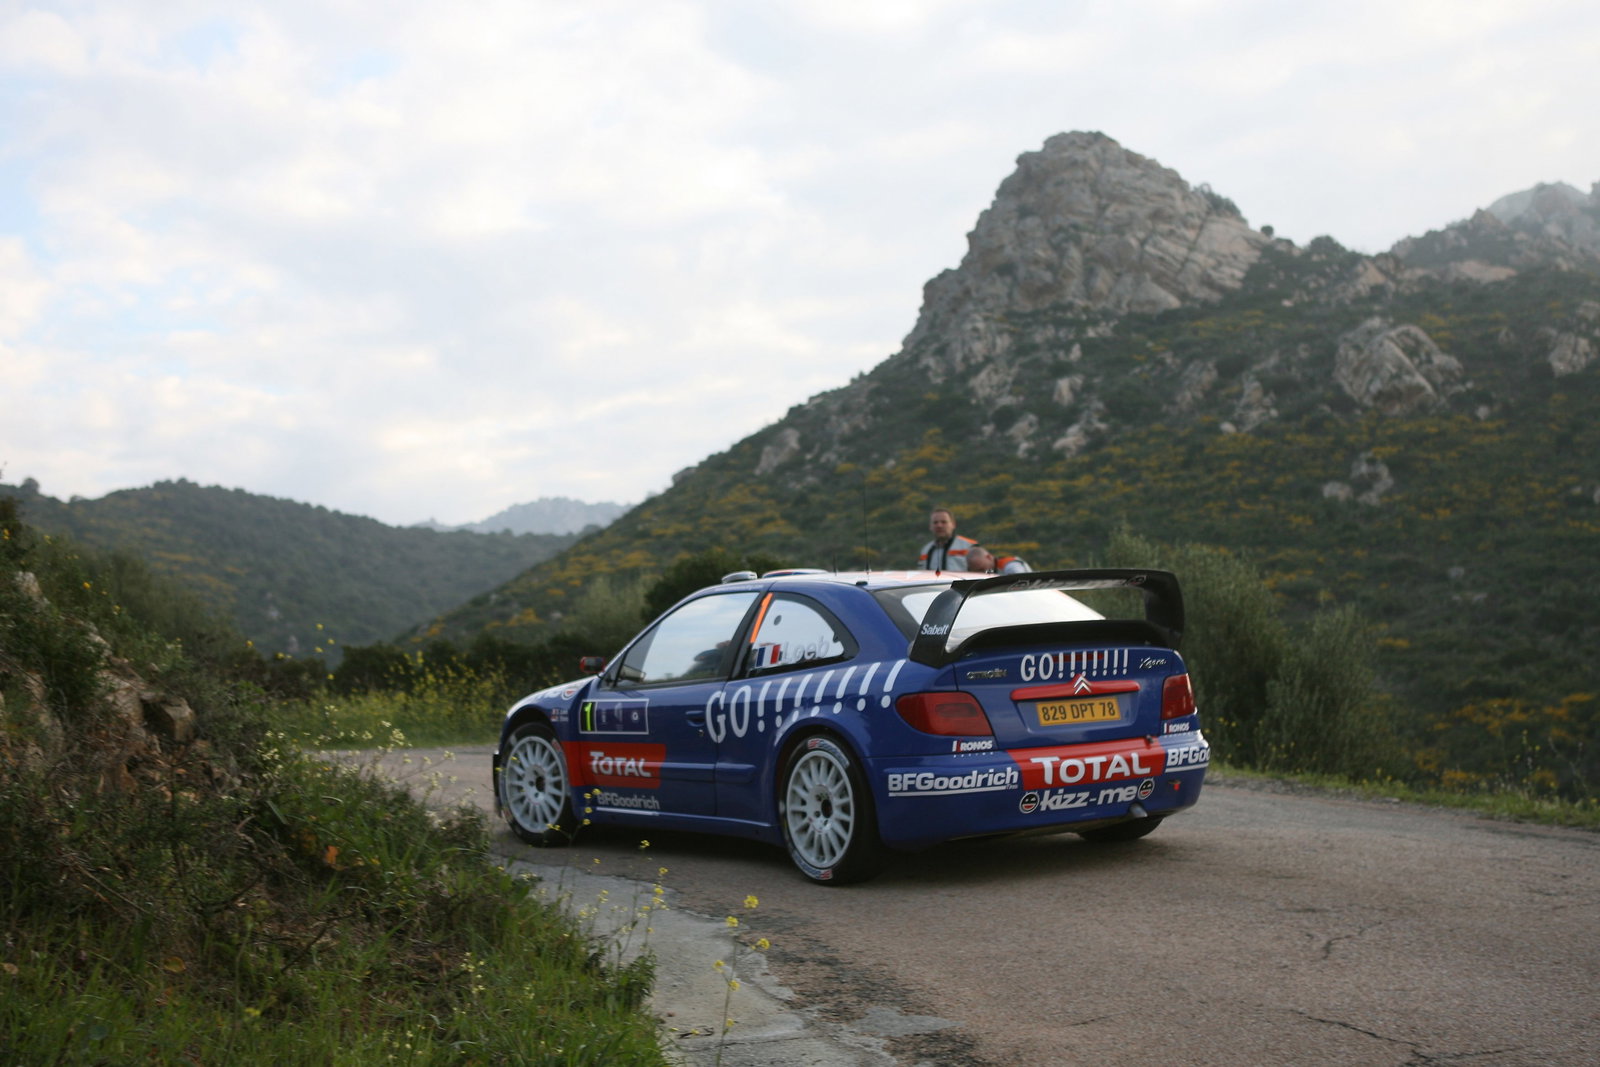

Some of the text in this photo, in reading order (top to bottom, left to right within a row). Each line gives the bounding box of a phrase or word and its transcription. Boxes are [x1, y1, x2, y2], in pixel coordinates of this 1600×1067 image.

[584, 701, 593, 732] 1
[1041, 701, 1116, 721] 829 DPT 78
[952, 739, 993, 752] KRONOS
[590, 751, 653, 778] TOTAL
[1030, 752, 1151, 785] TOTAL
[888, 767, 1019, 792] BFGoodrich
[597, 792, 661, 810] BFGoodrich
[1040, 785, 1138, 812] kizz-me
